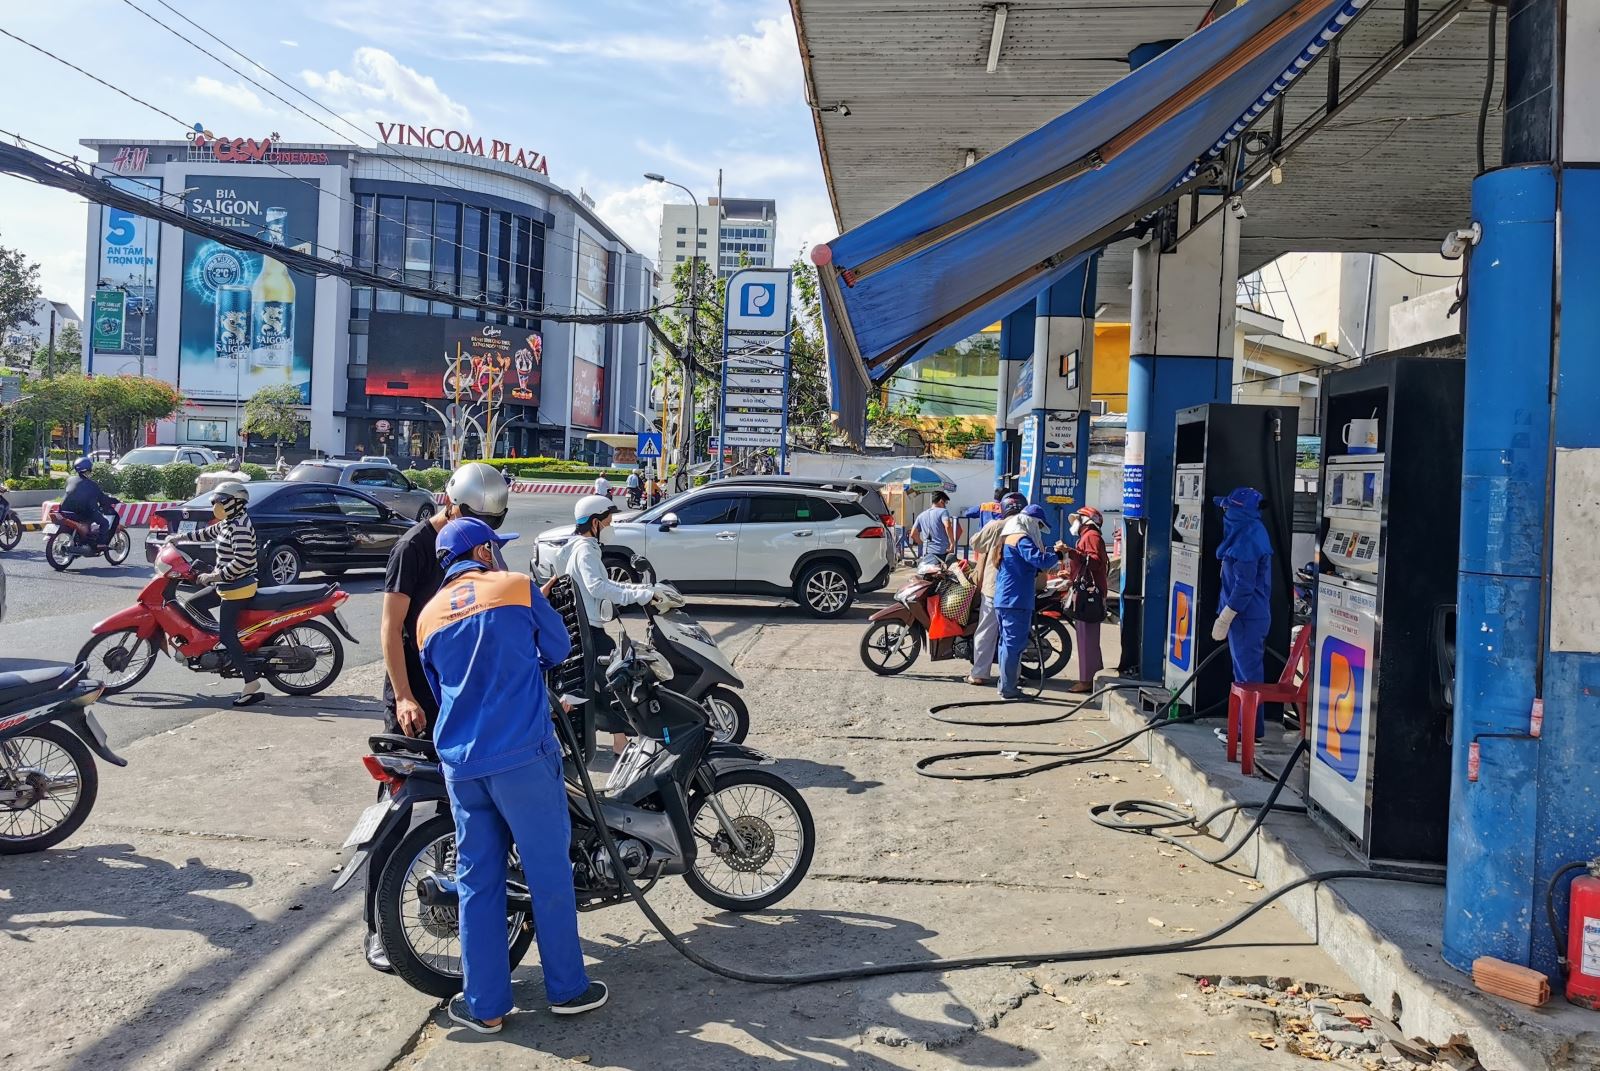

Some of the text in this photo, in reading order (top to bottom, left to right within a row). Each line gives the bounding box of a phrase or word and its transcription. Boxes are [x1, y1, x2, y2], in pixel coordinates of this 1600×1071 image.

[213, 137, 271, 161] CGV
[375, 121, 549, 175] VINCOM PLAZA
[112, 147, 149, 173] H&M
[269, 152, 328, 164] CINEMAS
[216, 189, 236, 199] BIA
[192, 199, 260, 215] SAIGON
[105, 207, 136, 246] 5
[107, 245, 143, 255] AN TÂM
[107, 256, 133, 266] TRỌN
